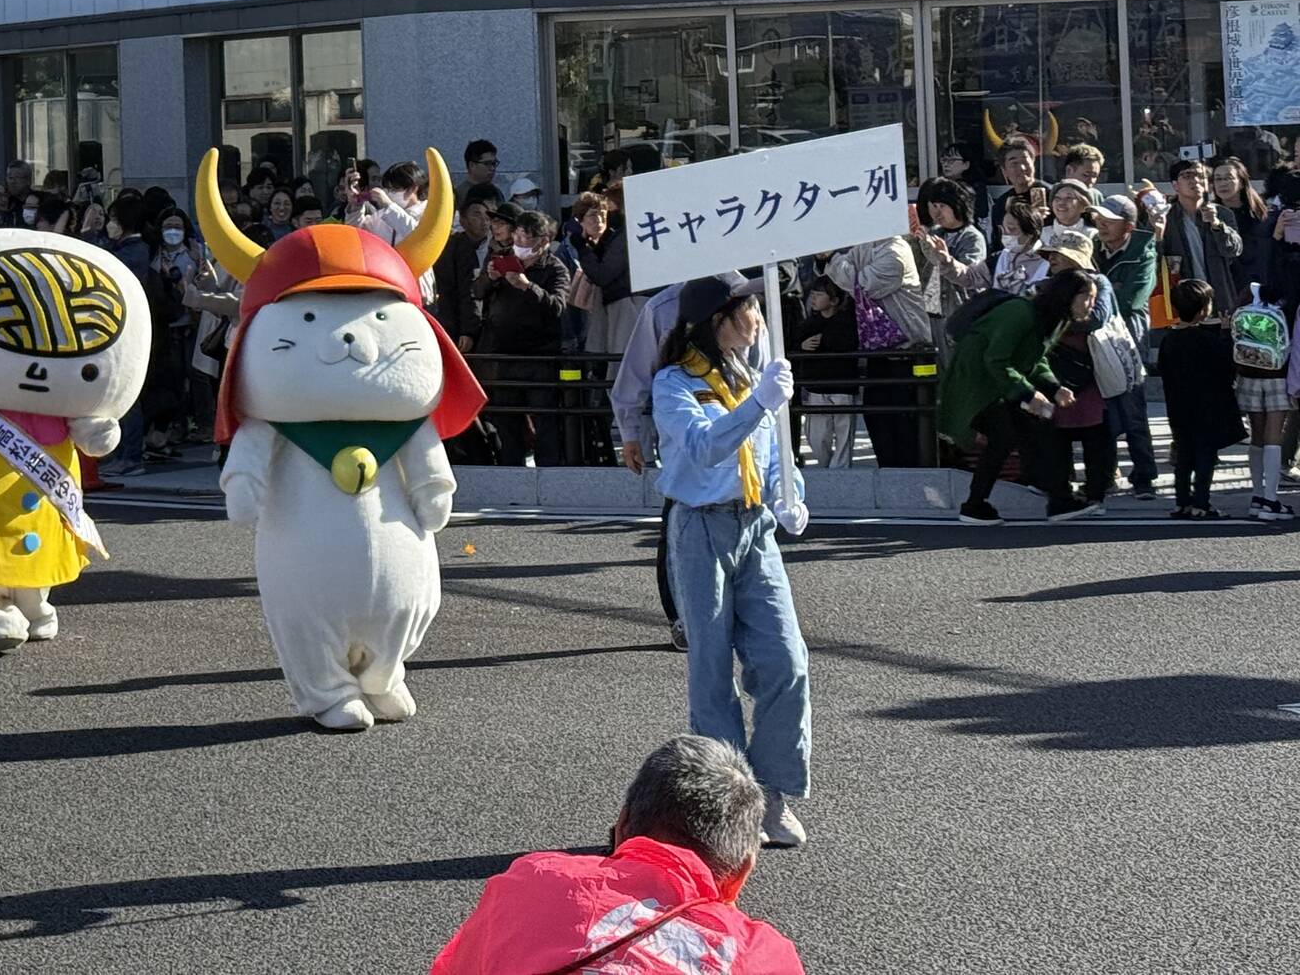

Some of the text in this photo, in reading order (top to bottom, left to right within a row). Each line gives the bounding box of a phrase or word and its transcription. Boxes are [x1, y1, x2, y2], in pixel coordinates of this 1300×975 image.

[636, 164, 898, 251] キャラクター列
